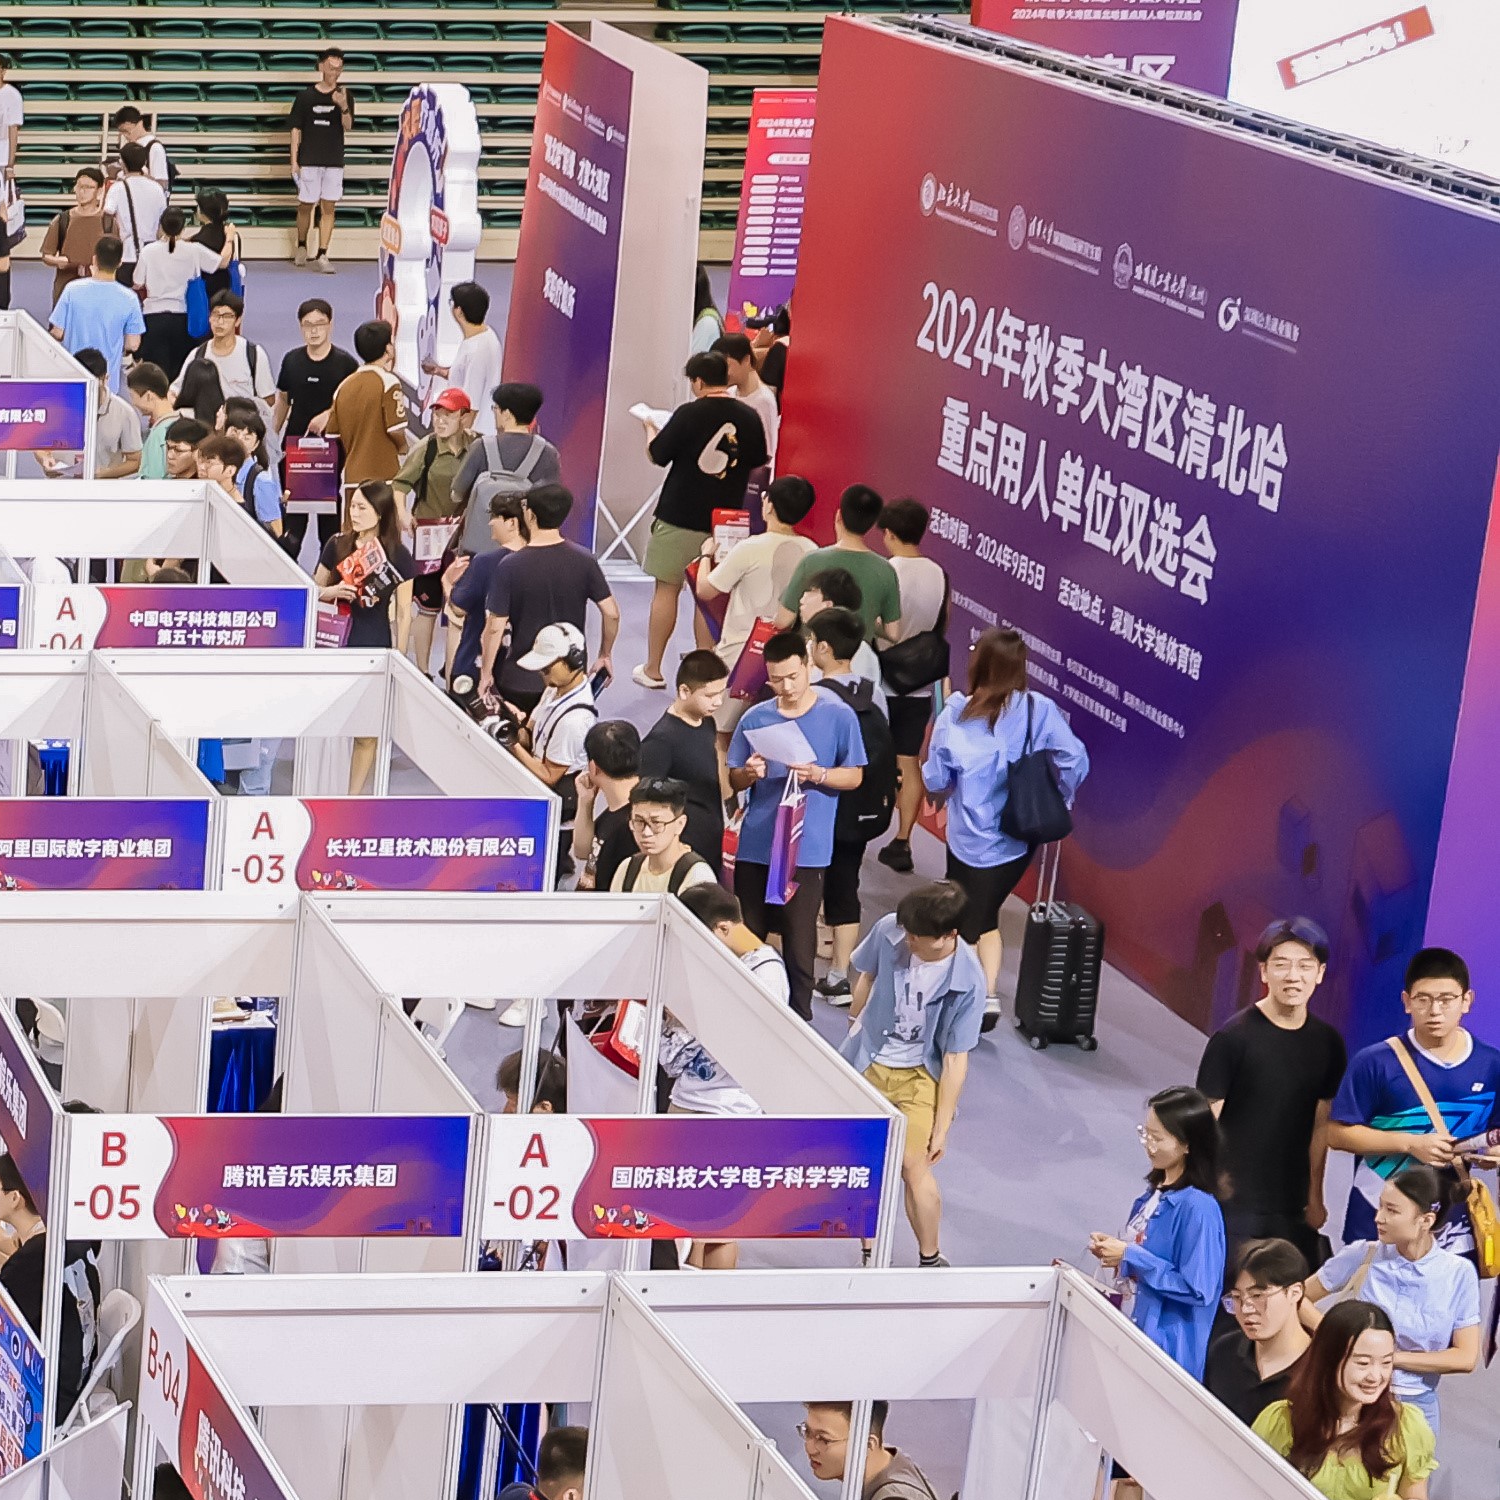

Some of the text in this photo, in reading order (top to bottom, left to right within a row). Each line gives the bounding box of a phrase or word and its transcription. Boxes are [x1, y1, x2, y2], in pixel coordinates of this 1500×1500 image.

[916, 283, 1288, 512] 2024年秋季大湾区清北哈
[937, 397, 1217, 605] 重点用人单位双选会
[57, 597, 76, 620] A
[129, 610, 277, 628] 中国电子科技集团公司
[157, 629, 245, 645] 第五十研究所
[252, 812, 275, 840] A
[326, 837, 535, 859] 长光卫星技术股份有限公司
[230, 855, 285, 883] -03
[101, 1133, 126, 1166] B
[521, 1134, 548, 1168] A
[224, 1164, 397, 1189] 腾讯音乐娱乐集团
[611, 1164, 870, 1192] 国防科技大学电子科学学院
[75, 1184, 141, 1219] -05
[493, 1186, 559, 1220] -02
[148, 1325, 181, 1414] B-04
